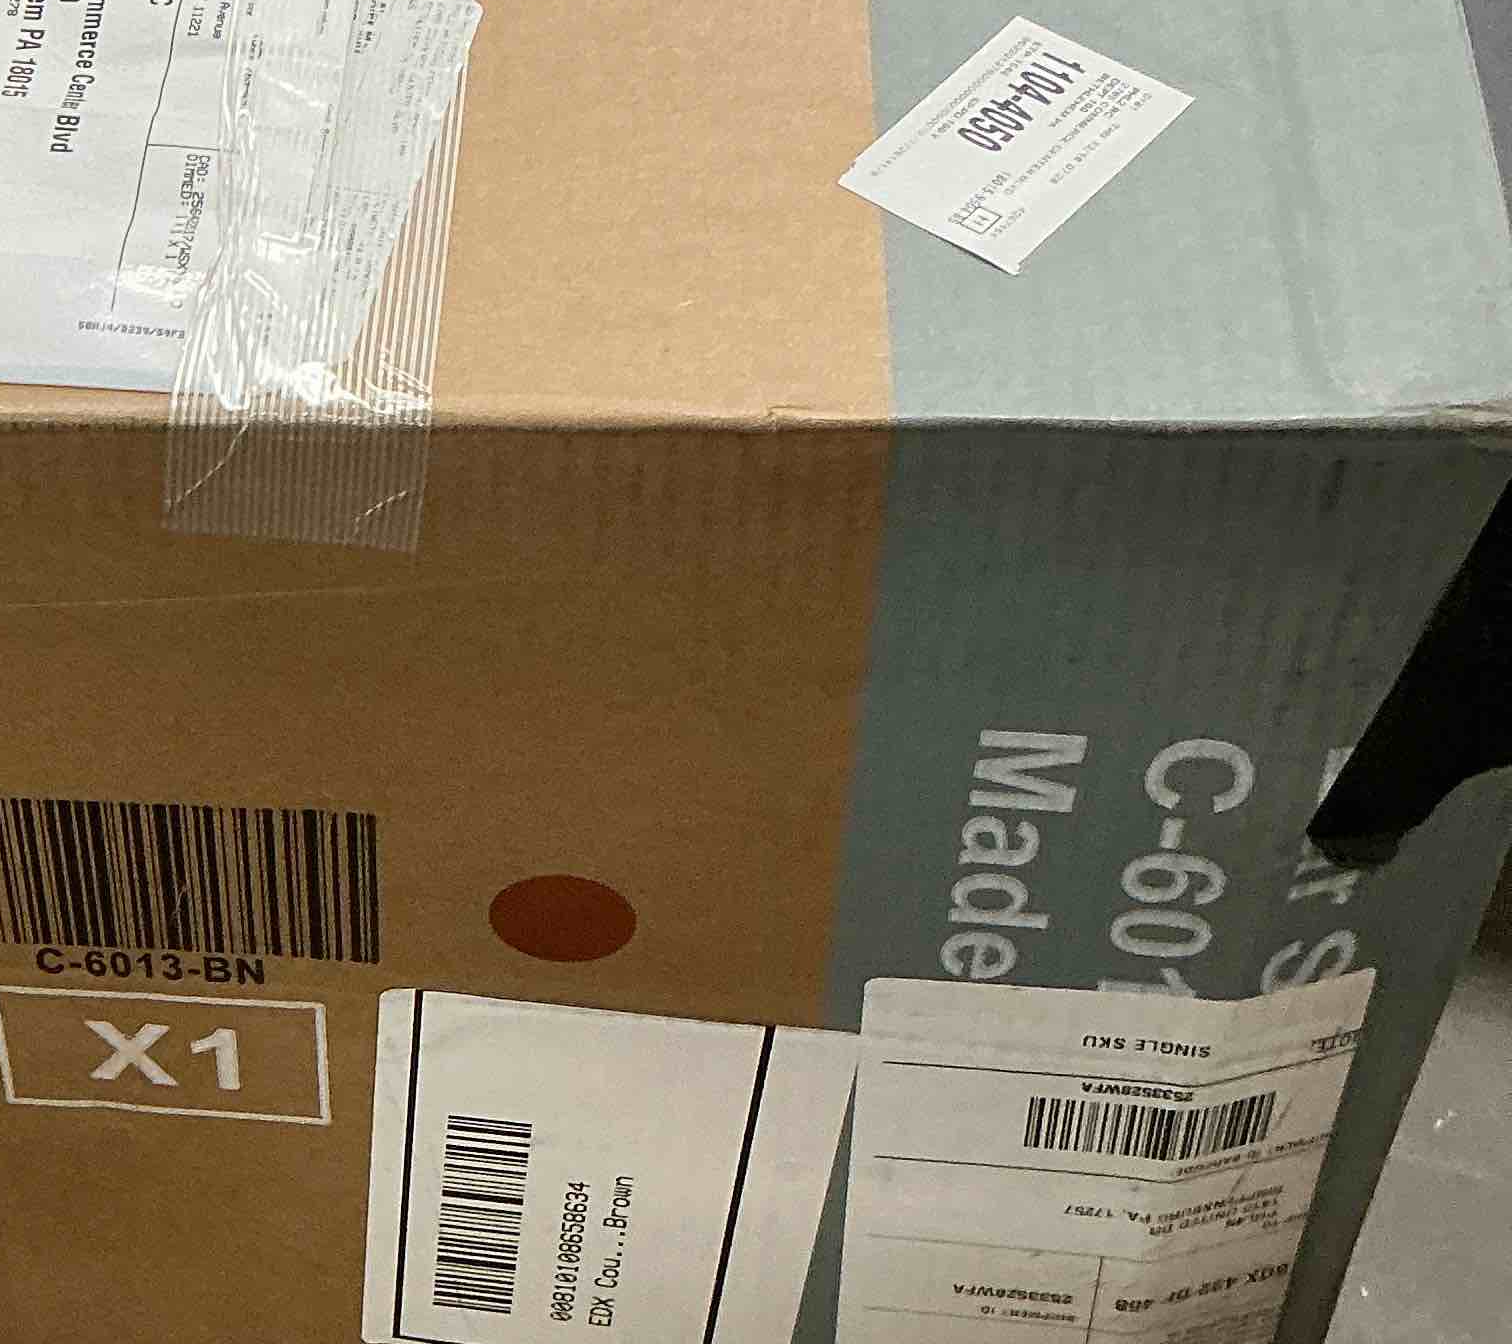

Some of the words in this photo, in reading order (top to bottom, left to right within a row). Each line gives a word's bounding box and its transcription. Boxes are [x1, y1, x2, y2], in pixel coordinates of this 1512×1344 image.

[15, 28, 45, 52] PA
[186, 5, 206, 37] 11221
[1, 57, 38, 99] 18015
[956, 52, 1086, 152] 1104-4050
[49, 114, 81, 154] Blvd
[939, 729, 1089, 980] Made
[35, 947, 267, 986] C-6013-BN
[84, 1020, 242, 1092] X1
[1081, 1033, 1127, 1051] SKU
[1135, 1037, 1212, 1059] SINGLE
[549, 1181, 591, 1323] 00810108658634
[588, 1295, 616, 1328] EDX
